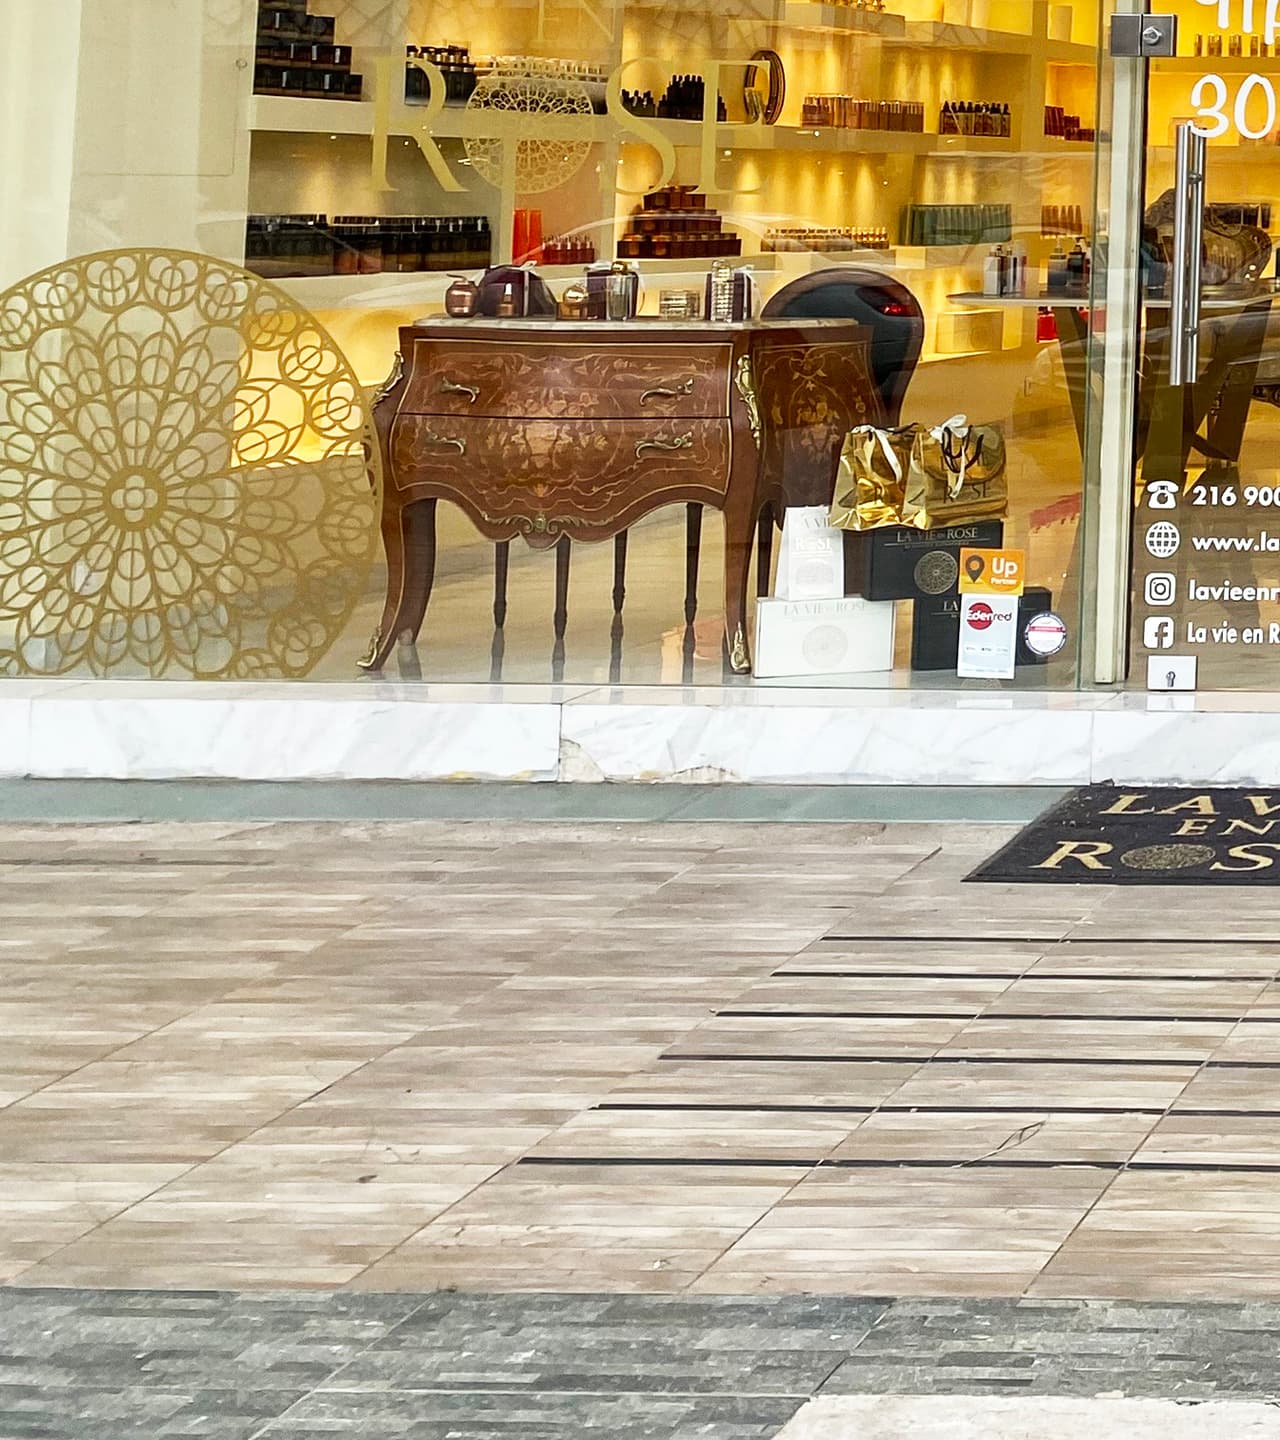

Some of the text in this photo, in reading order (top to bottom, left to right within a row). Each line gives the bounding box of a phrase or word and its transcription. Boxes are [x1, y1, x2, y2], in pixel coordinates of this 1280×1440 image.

[1191, 485, 1237, 507] 216
[946, 526, 978, 539] ROSE
[991, 556, 1019, 578] Up
[967, 609, 1013, 622] Edenred
[1187, 621, 1207, 645] La
[1209, 621, 1238, 645] vie
[1242, 627, 1264, 646] en
[1099, 793, 1221, 817] LA
